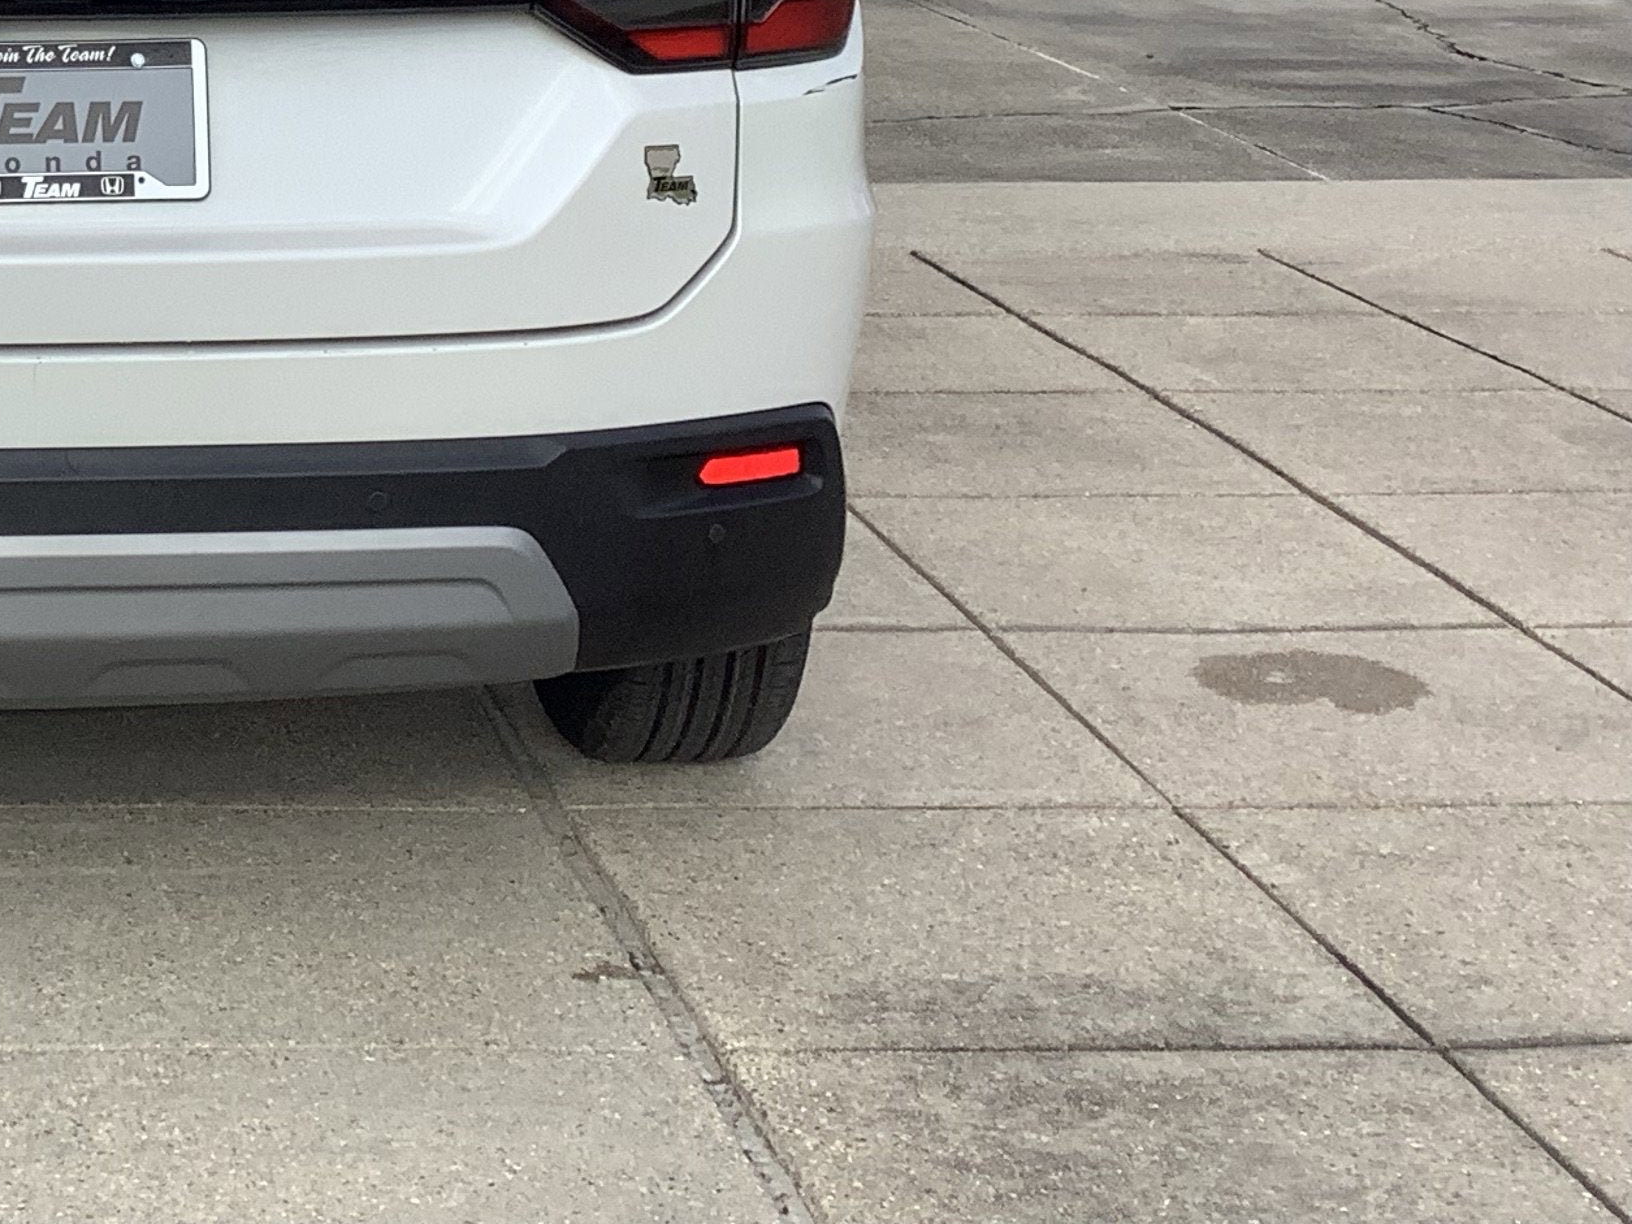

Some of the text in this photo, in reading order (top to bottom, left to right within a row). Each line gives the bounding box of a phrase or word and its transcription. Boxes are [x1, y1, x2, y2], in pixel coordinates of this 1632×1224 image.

[22, 44, 56, 64] The
[58, 43, 116, 63] Team!
[21, 176, 81, 199] TEAM
[652, 176, 689, 192] TEAM
